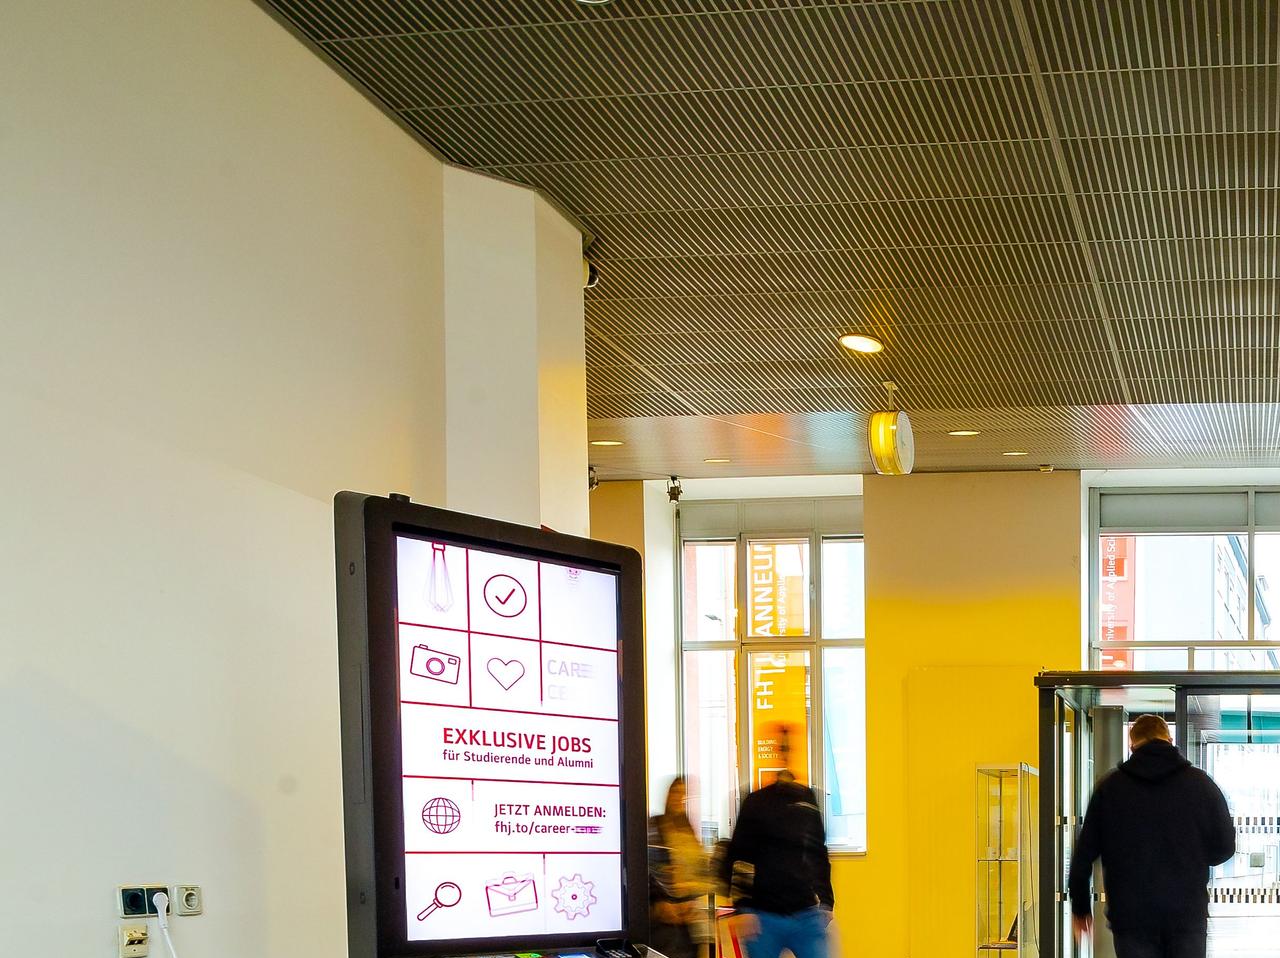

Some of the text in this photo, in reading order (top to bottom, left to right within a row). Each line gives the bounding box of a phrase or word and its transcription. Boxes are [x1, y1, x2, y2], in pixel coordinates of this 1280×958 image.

[755, 681, 774, 710] FH
[442, 727, 592, 755] EXKLUSIVE JOBS
[442, 749, 594, 769] für Studierende und Alumni
[494, 804, 607, 818] JETZT ANMELDEN:
